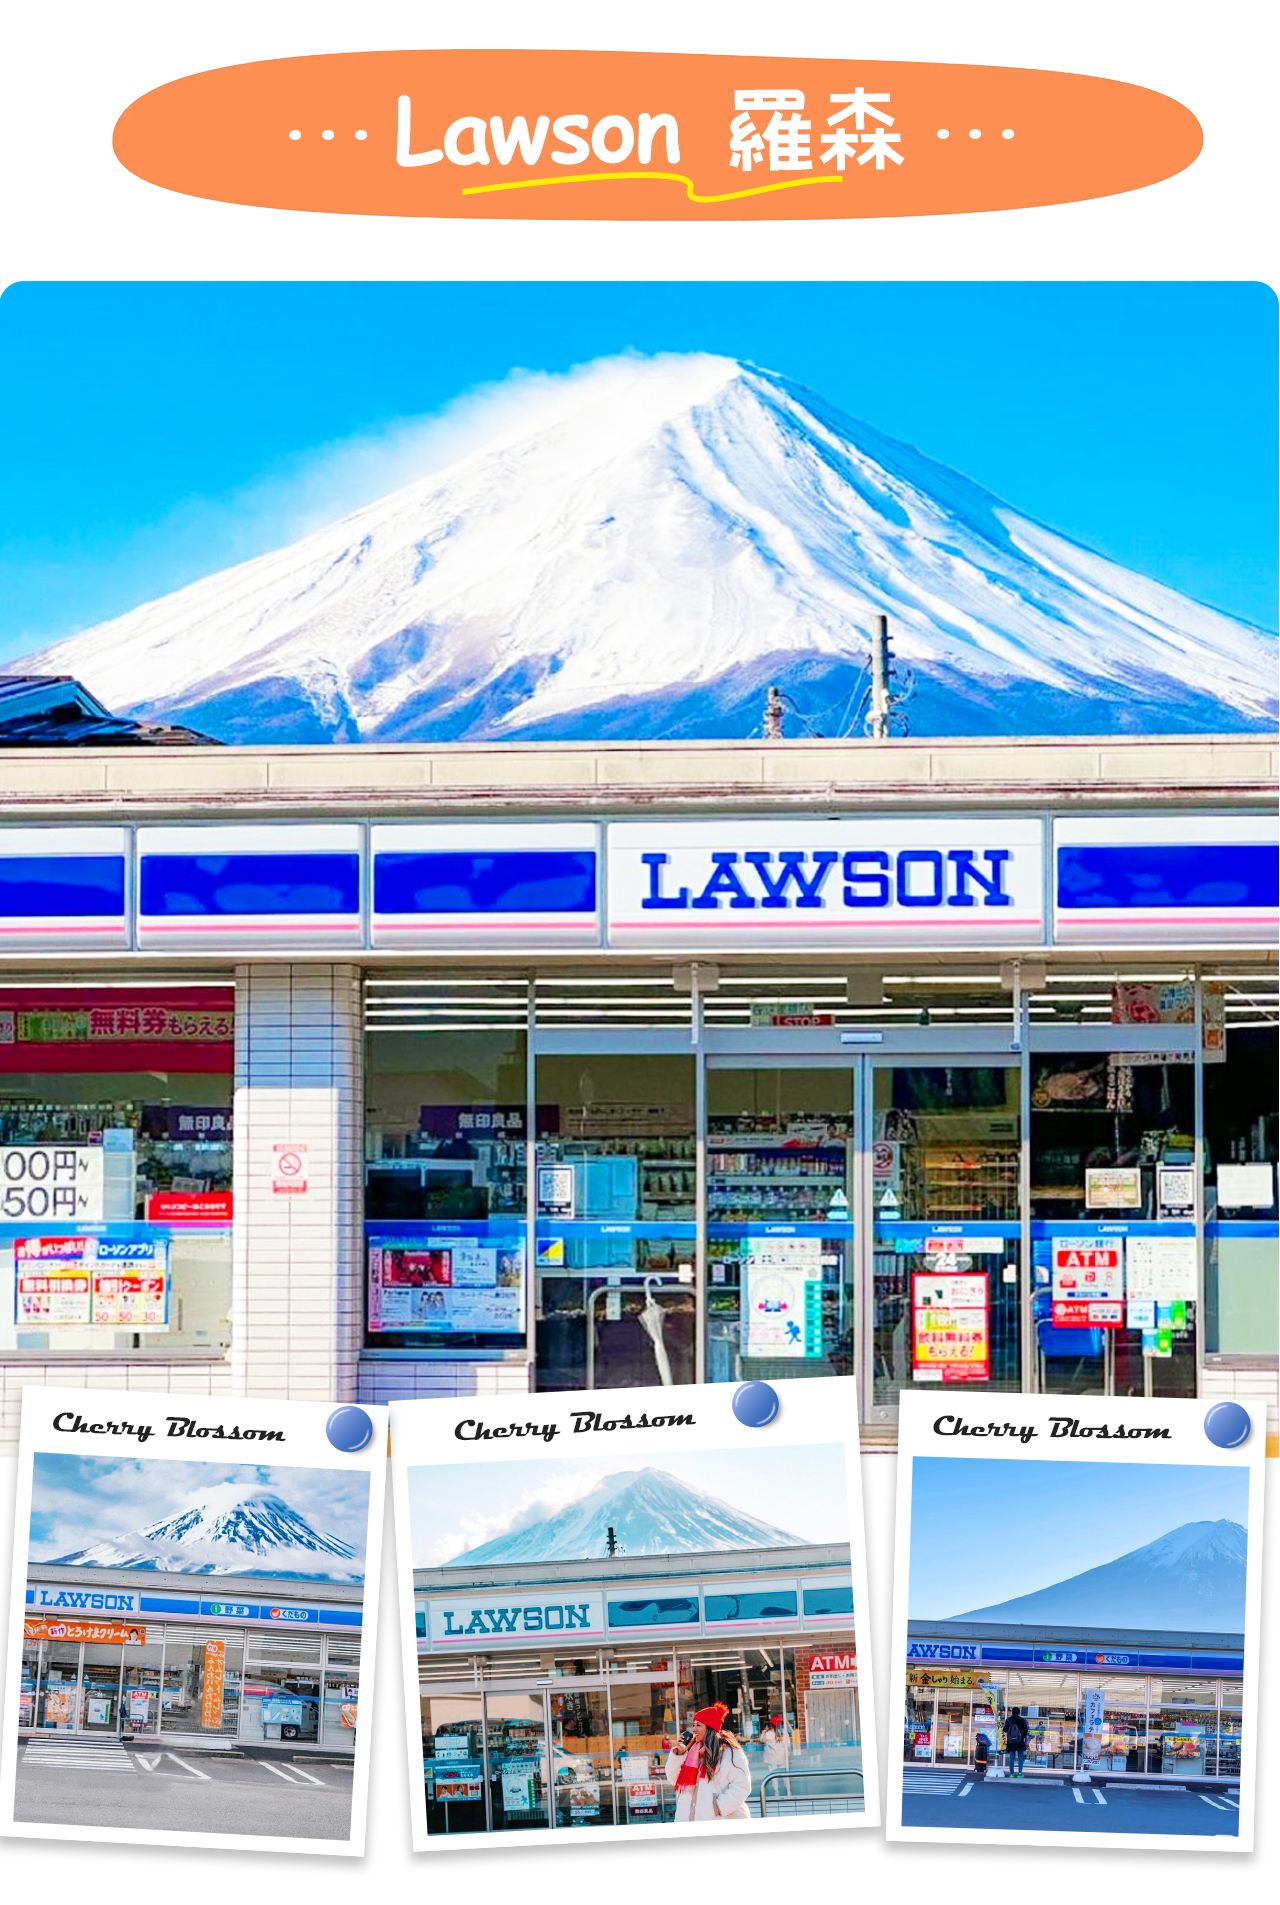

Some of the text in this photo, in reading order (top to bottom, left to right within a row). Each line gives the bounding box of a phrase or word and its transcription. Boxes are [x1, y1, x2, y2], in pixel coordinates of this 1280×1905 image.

[641, 848, 1012, 909] LAWSON
[458, 1112, 522, 1129] 無印良品
[99, 1243, 153, 1256] ローソンアプリ
[935, 1253, 957, 1266] 24
[1066, 1252, 1110, 1266] ATM
[40, 1590, 134, 1611] LAWSON
[224, 1605, 245, 1615] 野菜
[282, 1610, 307, 1619] くだもの
[443, 1603, 591, 1636] LAWSON
[810, 1654, 850, 1671] ATM
[1055, 1652, 1073, 1662] 野菜
[1104, 1655, 1128, 1664] くだもの
[632, 1783, 653, 1791] ATM
